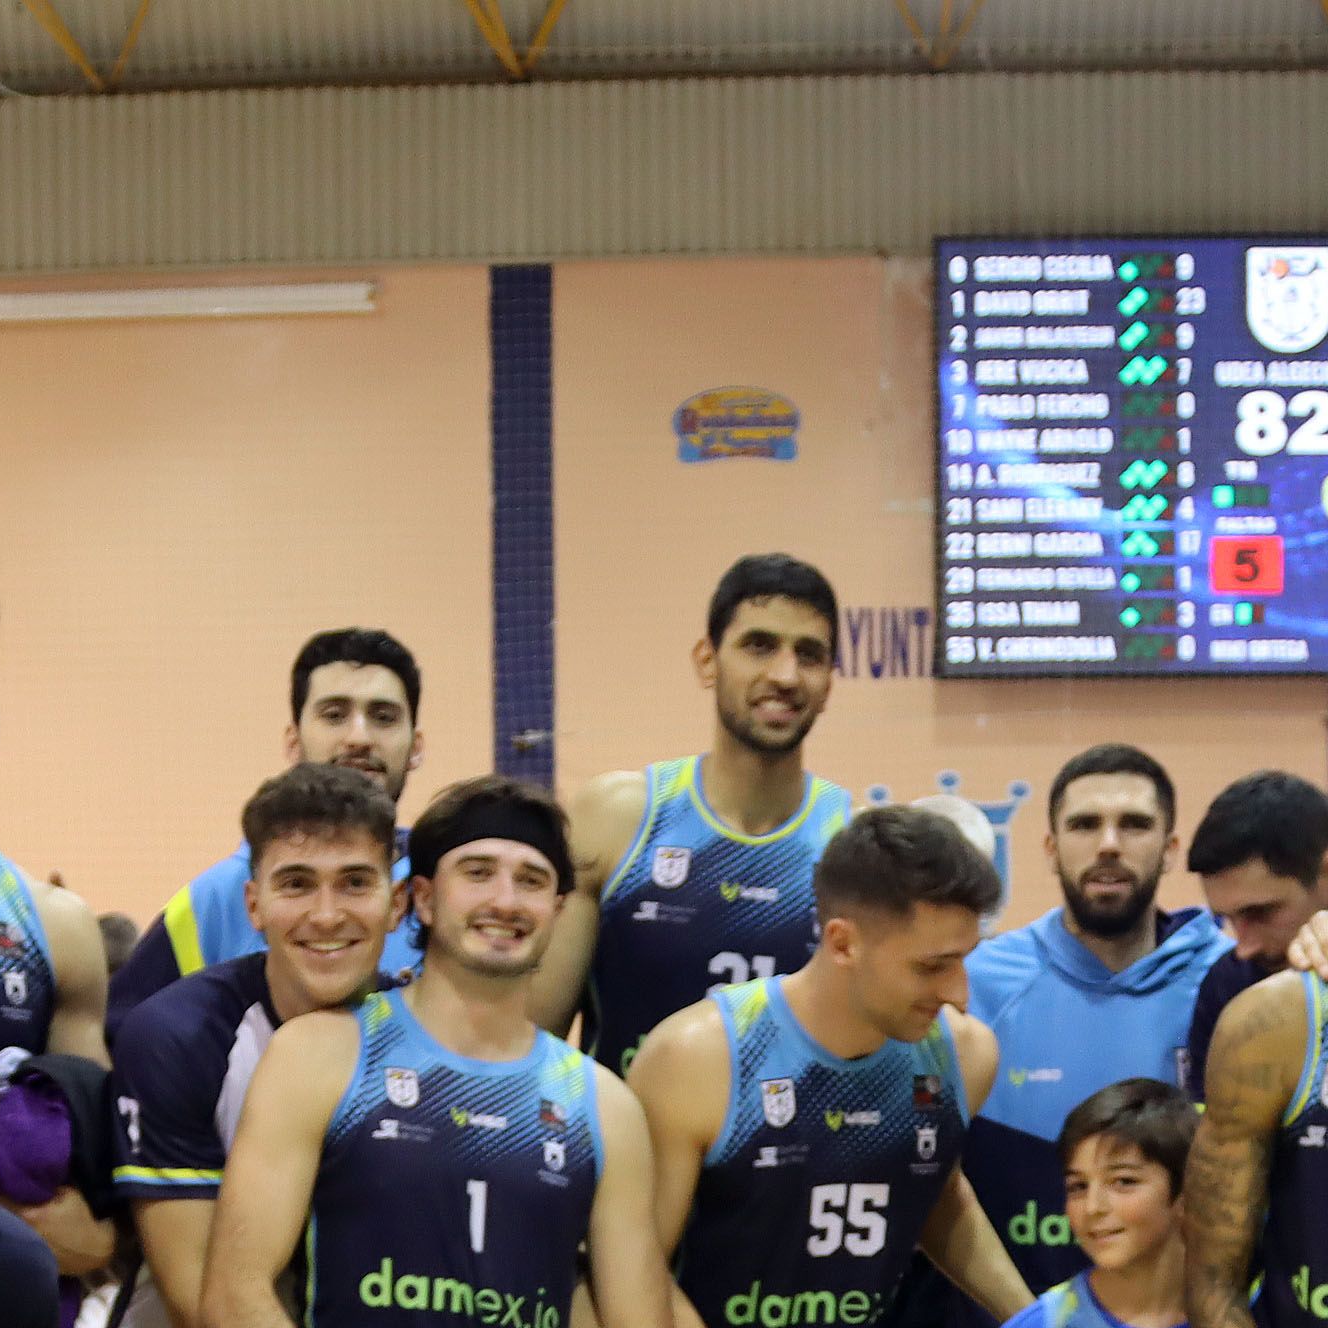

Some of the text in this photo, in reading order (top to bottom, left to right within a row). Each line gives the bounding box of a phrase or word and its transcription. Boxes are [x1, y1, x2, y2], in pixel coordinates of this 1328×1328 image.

[1234, 549, 1260, 582] 5
[466, 1179, 488, 1253] 1
[807, 1183, 890, 1258] 55
[1008, 1200, 1080, 1247] da
